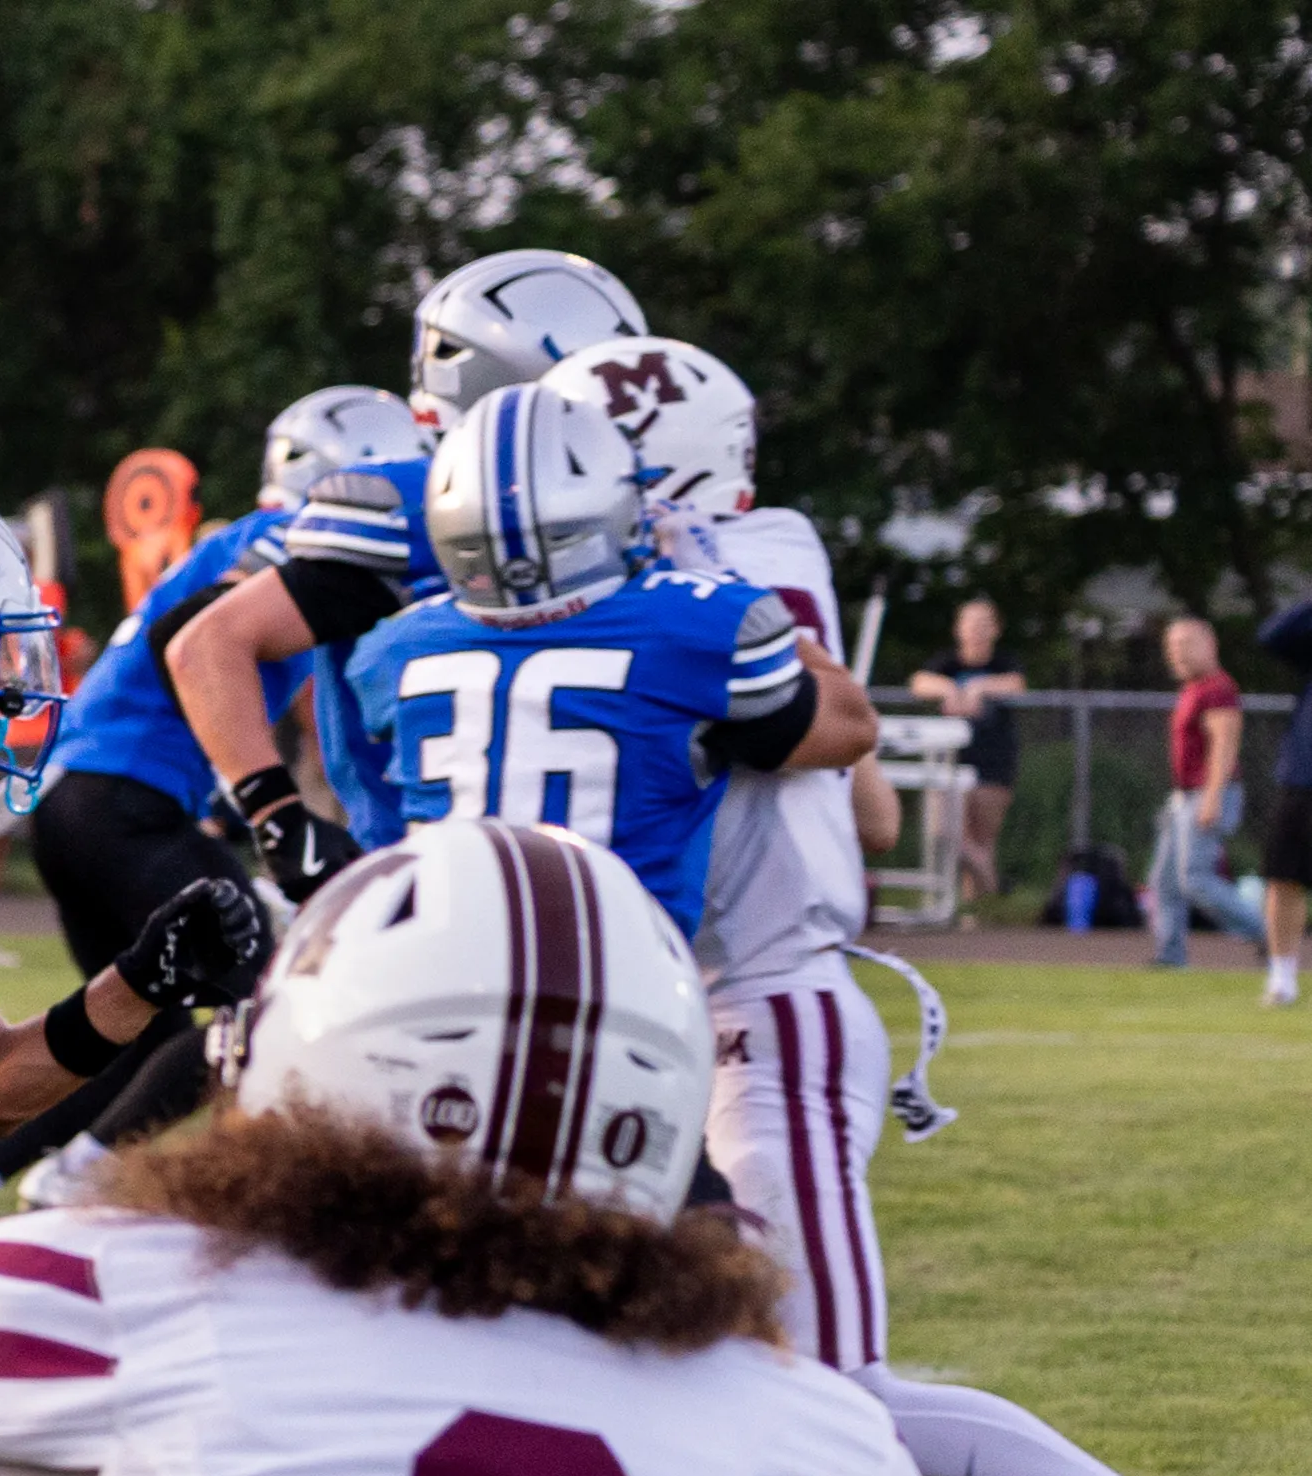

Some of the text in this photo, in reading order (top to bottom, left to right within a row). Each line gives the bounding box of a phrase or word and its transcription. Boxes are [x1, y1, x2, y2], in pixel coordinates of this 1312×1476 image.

[589, 351, 687, 419] M
[397, 647, 634, 849] 36
[602, 1110, 647, 1168] 0
